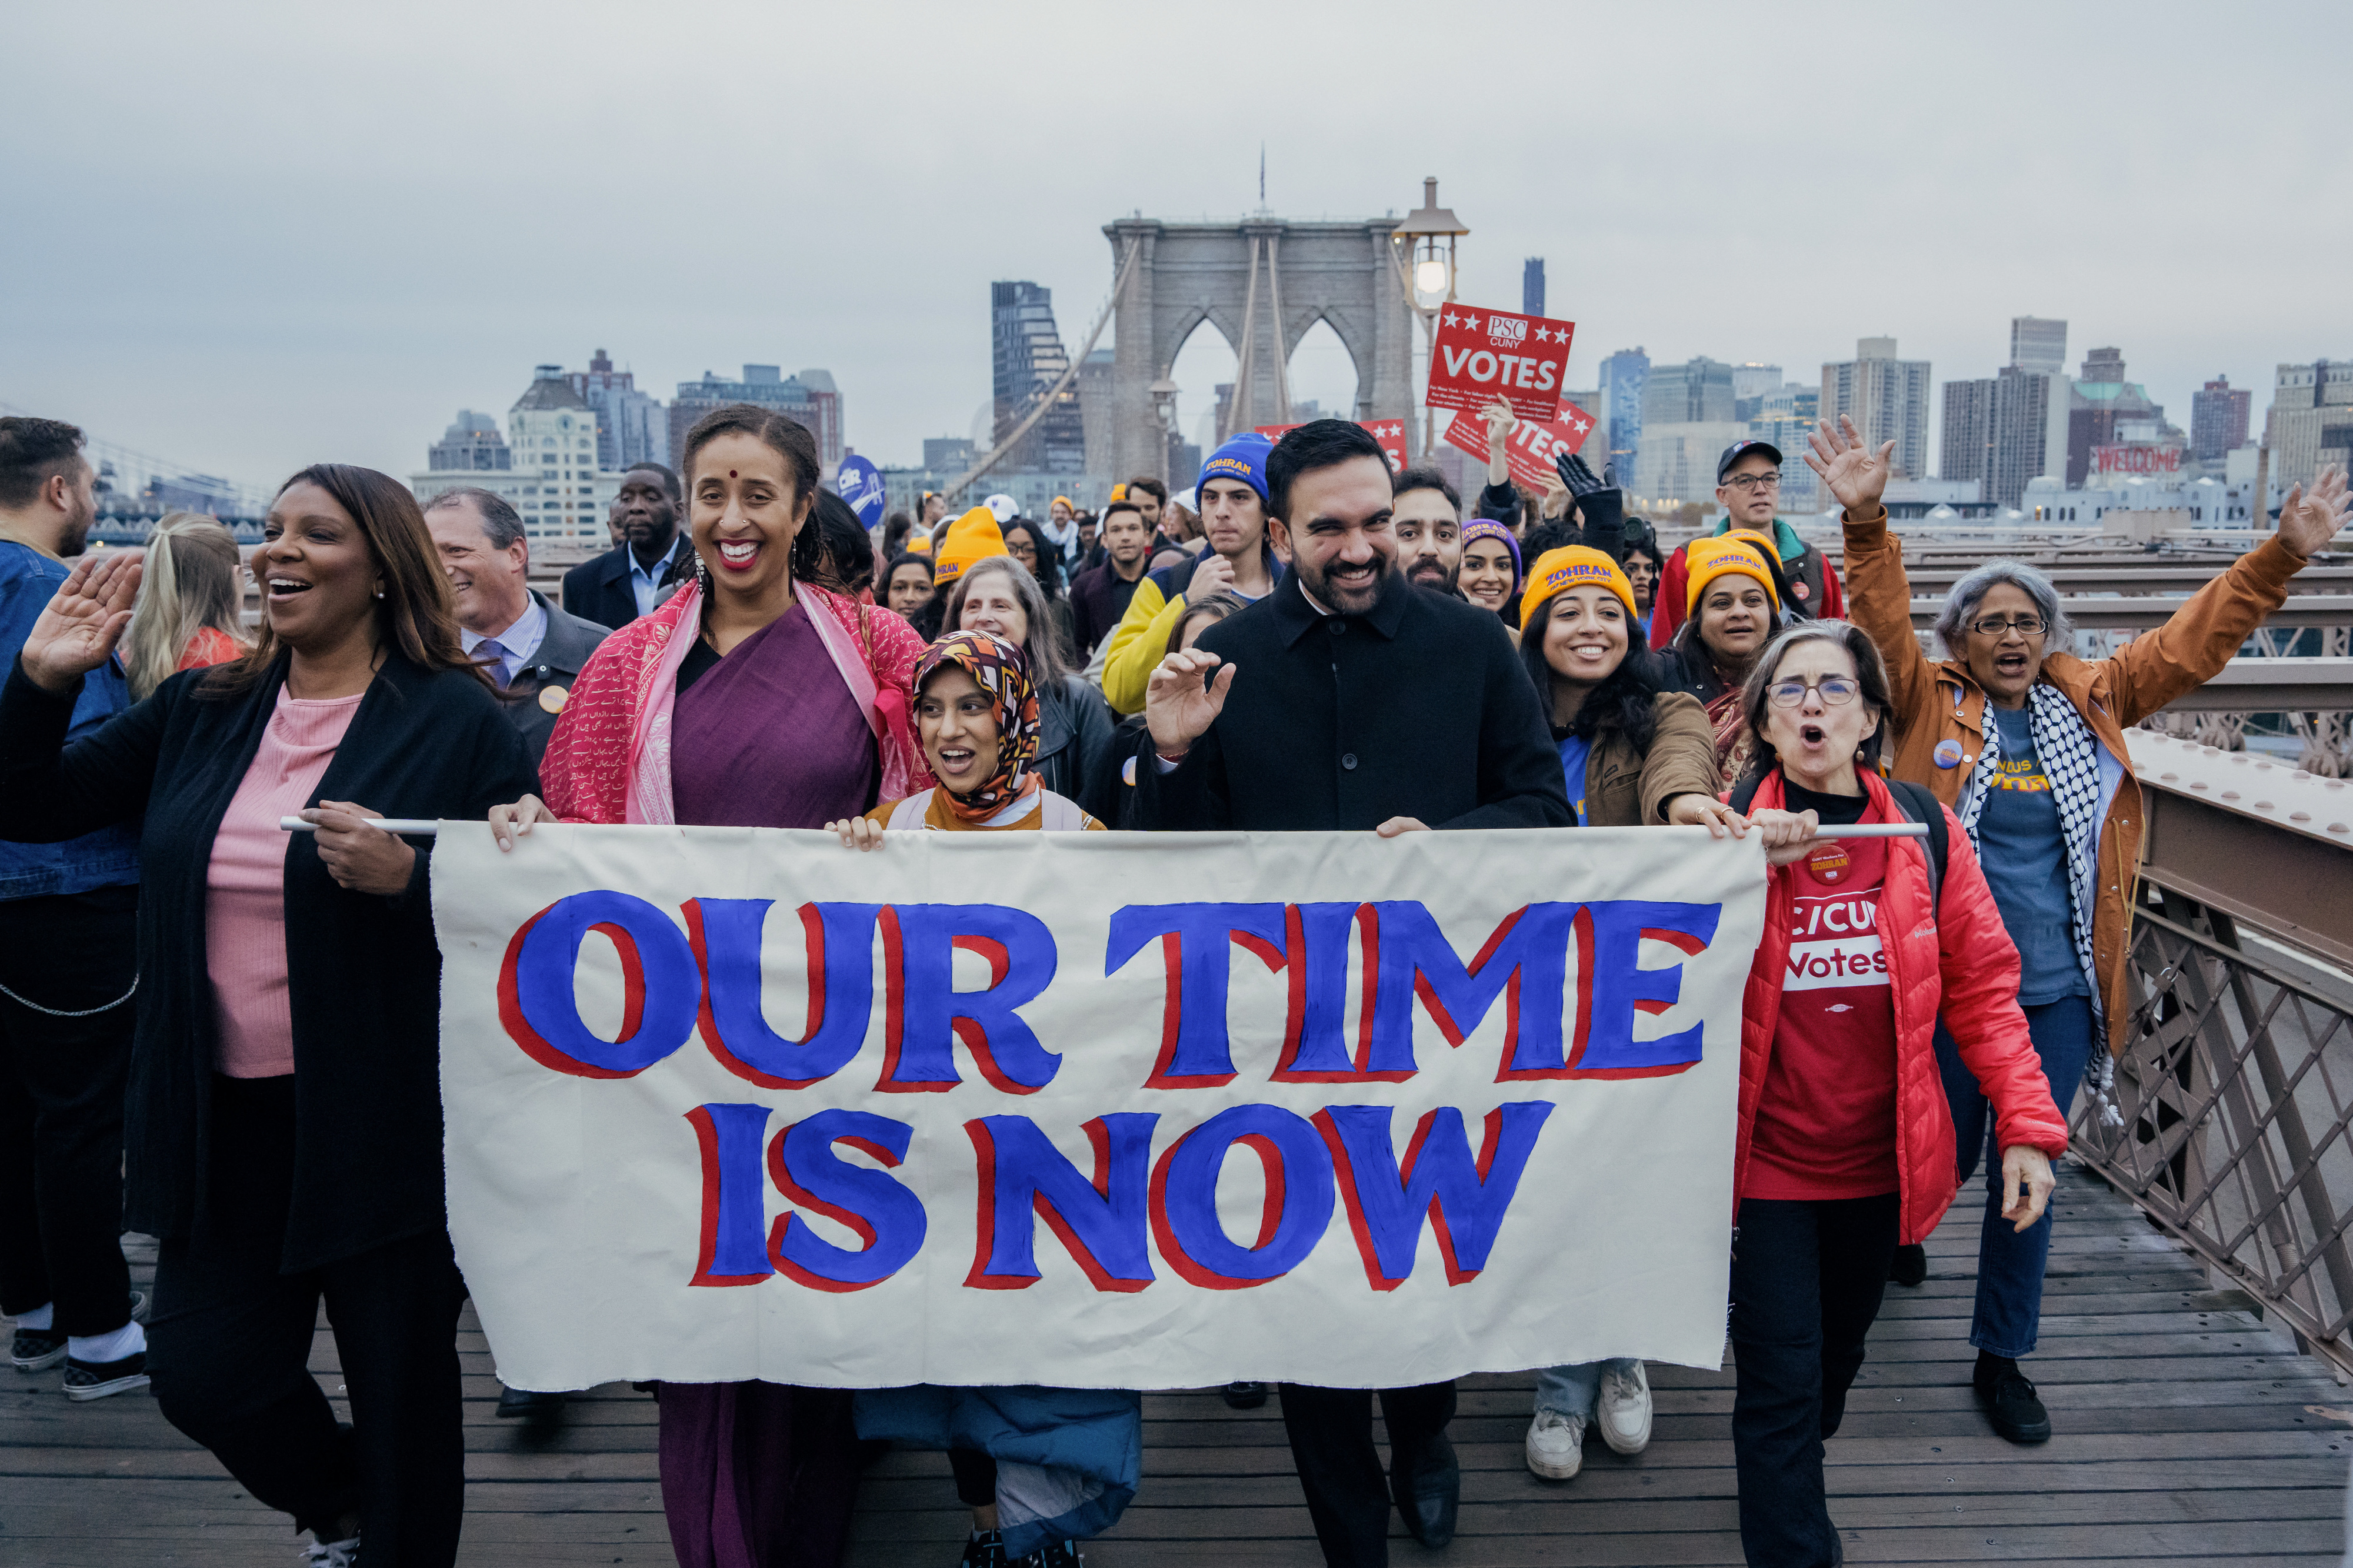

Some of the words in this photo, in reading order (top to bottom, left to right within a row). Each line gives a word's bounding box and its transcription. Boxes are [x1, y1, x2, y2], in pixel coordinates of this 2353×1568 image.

[1490, 317, 1527, 339] PSC
[1490, 337, 1521, 349] CUNY
[1442, 345, 1558, 391] VOTES
[2098, 446, 2179, 472] WELCOME
[1469, 530, 1481, 539] NEW
[1497, 531, 1508, 541] CITY
[1707, 555, 1761, 570] ZOHRAN
[1546, 565, 1612, 587] ZOHRAN
[1560, 578, 1575, 586] NEW
[1997, 759, 2032, 773] NDUS
[1811, 858, 1848, 870] ZOHRAN
[1787, 948, 1887, 979] Votes
[497, 890, 1062, 1095] OUR
[1105, 900, 1722, 1090] TIME
[684, 1103, 927, 1293] IS
[963, 1100, 1556, 1293] NOW
